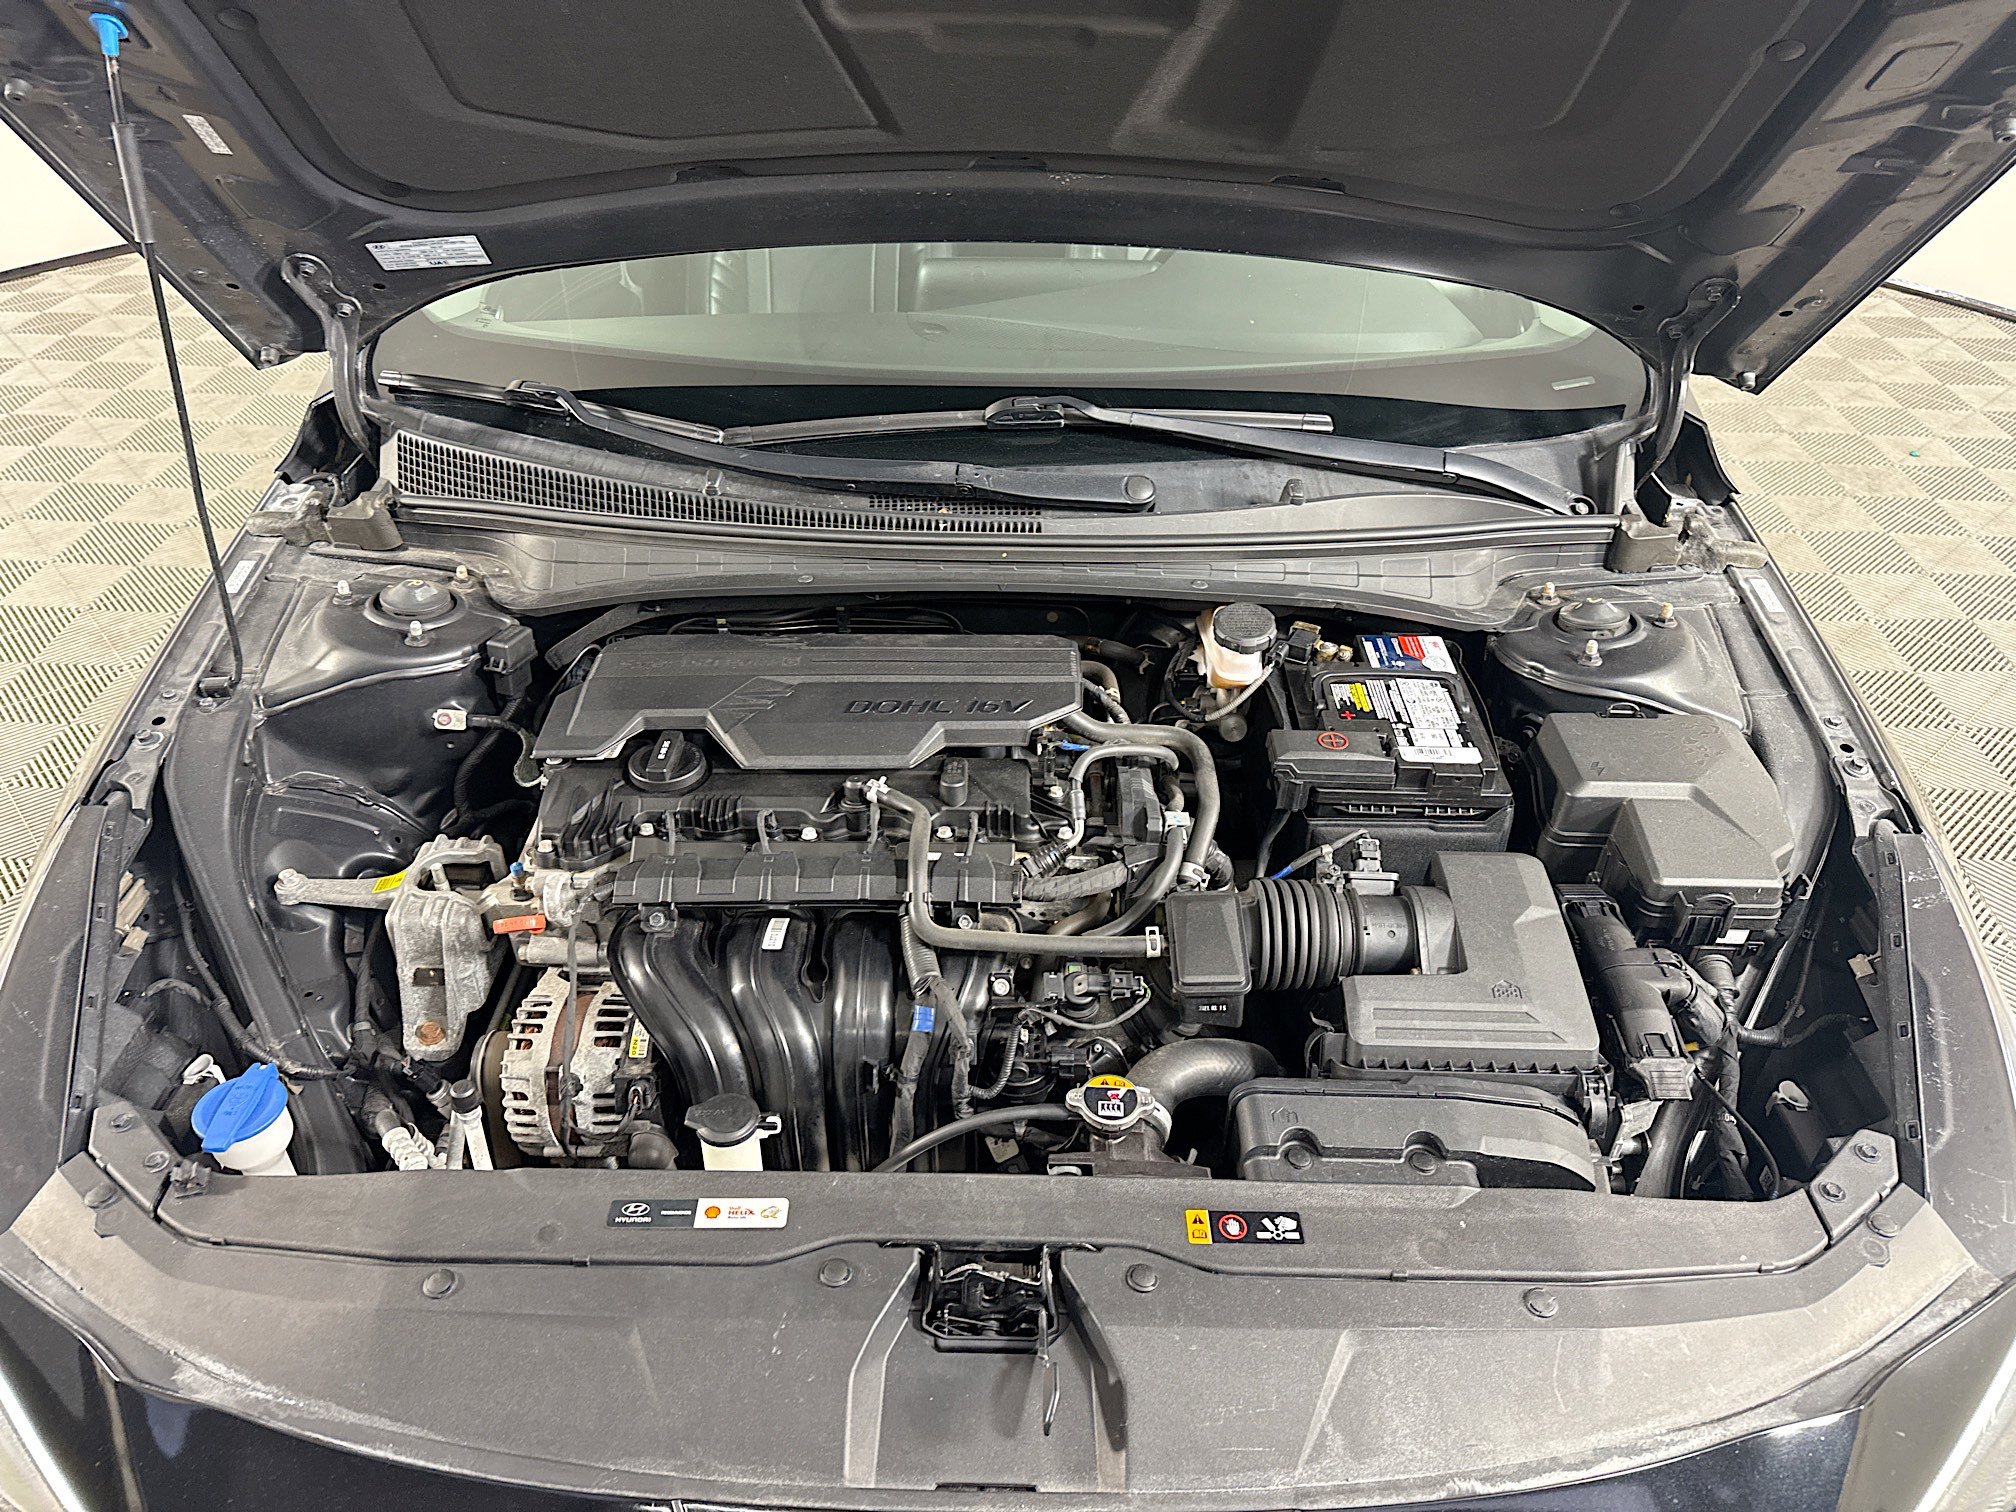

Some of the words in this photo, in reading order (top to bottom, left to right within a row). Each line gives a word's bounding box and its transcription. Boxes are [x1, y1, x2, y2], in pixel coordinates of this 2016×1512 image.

[843, 699, 953, 715] DOHC
[966, 699, 1033, 714] 16V
[614, 1216, 652, 1224] HYUNDAI
